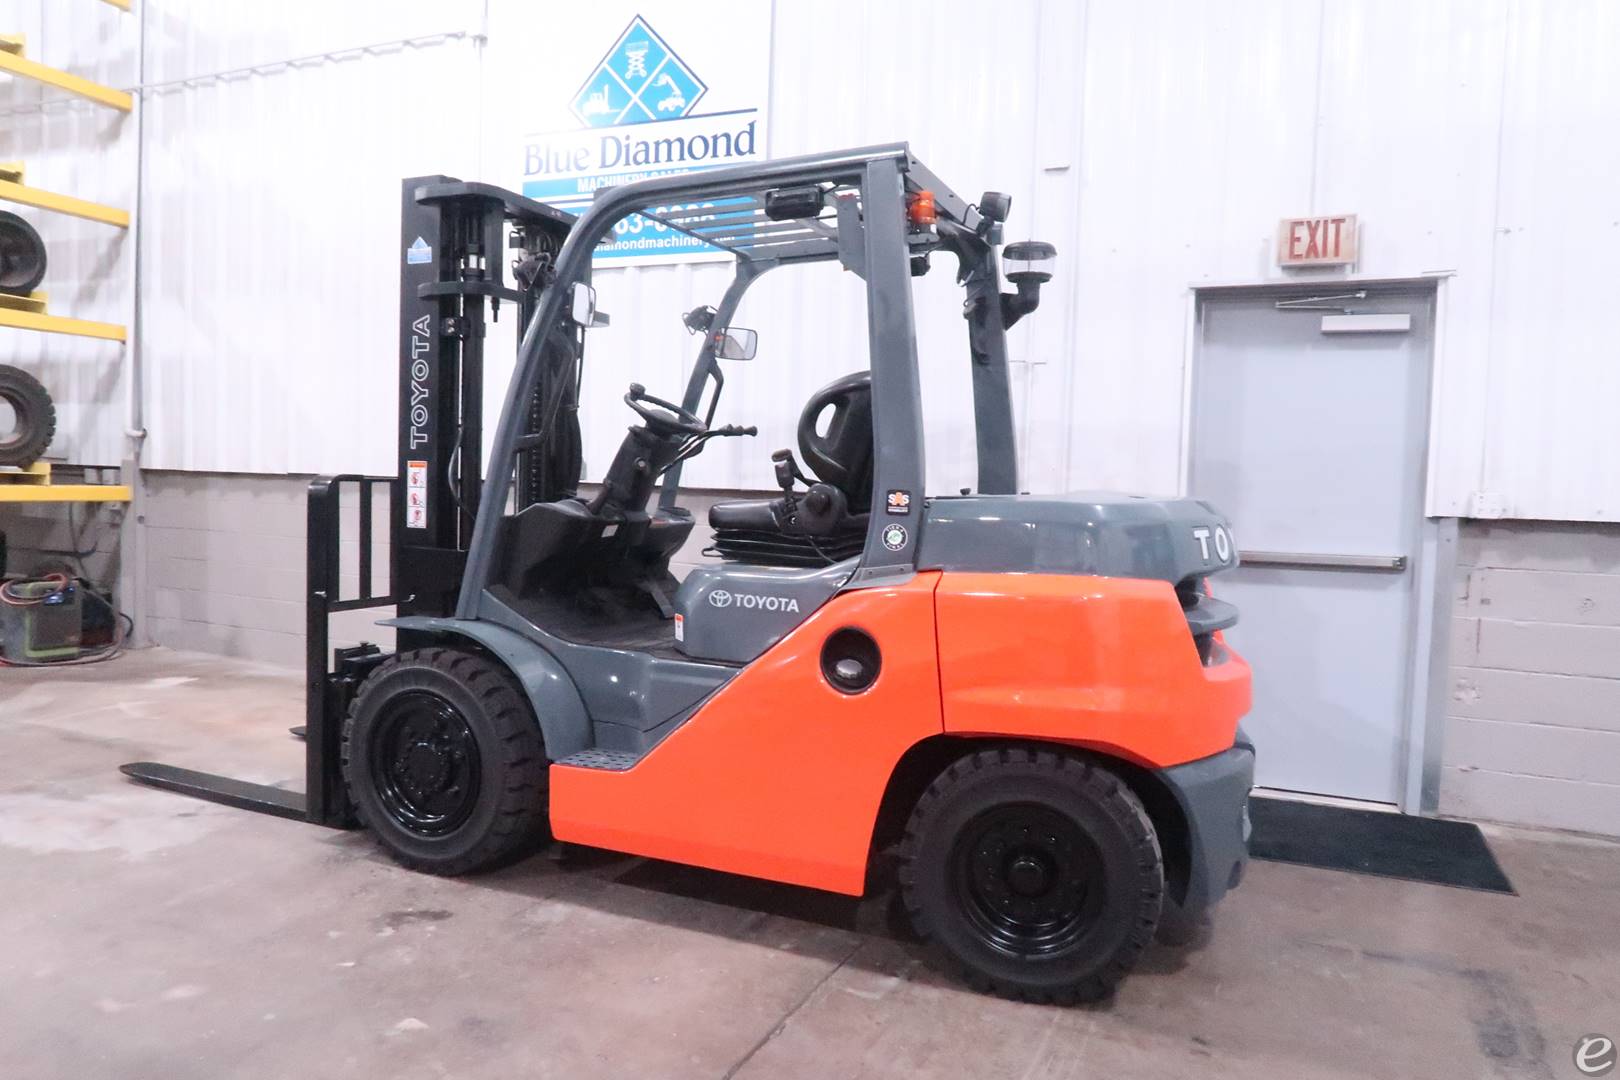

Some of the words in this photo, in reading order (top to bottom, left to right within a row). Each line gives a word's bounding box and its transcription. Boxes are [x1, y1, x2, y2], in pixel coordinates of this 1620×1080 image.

[523, 142, 590, 176] Blue
[599, 120, 757, 169] Diamond
[1289, 218, 1346, 260] EXIT
[410, 315, 431, 449] TOYOTA
[734, 594, 799, 612] TOYOTA
